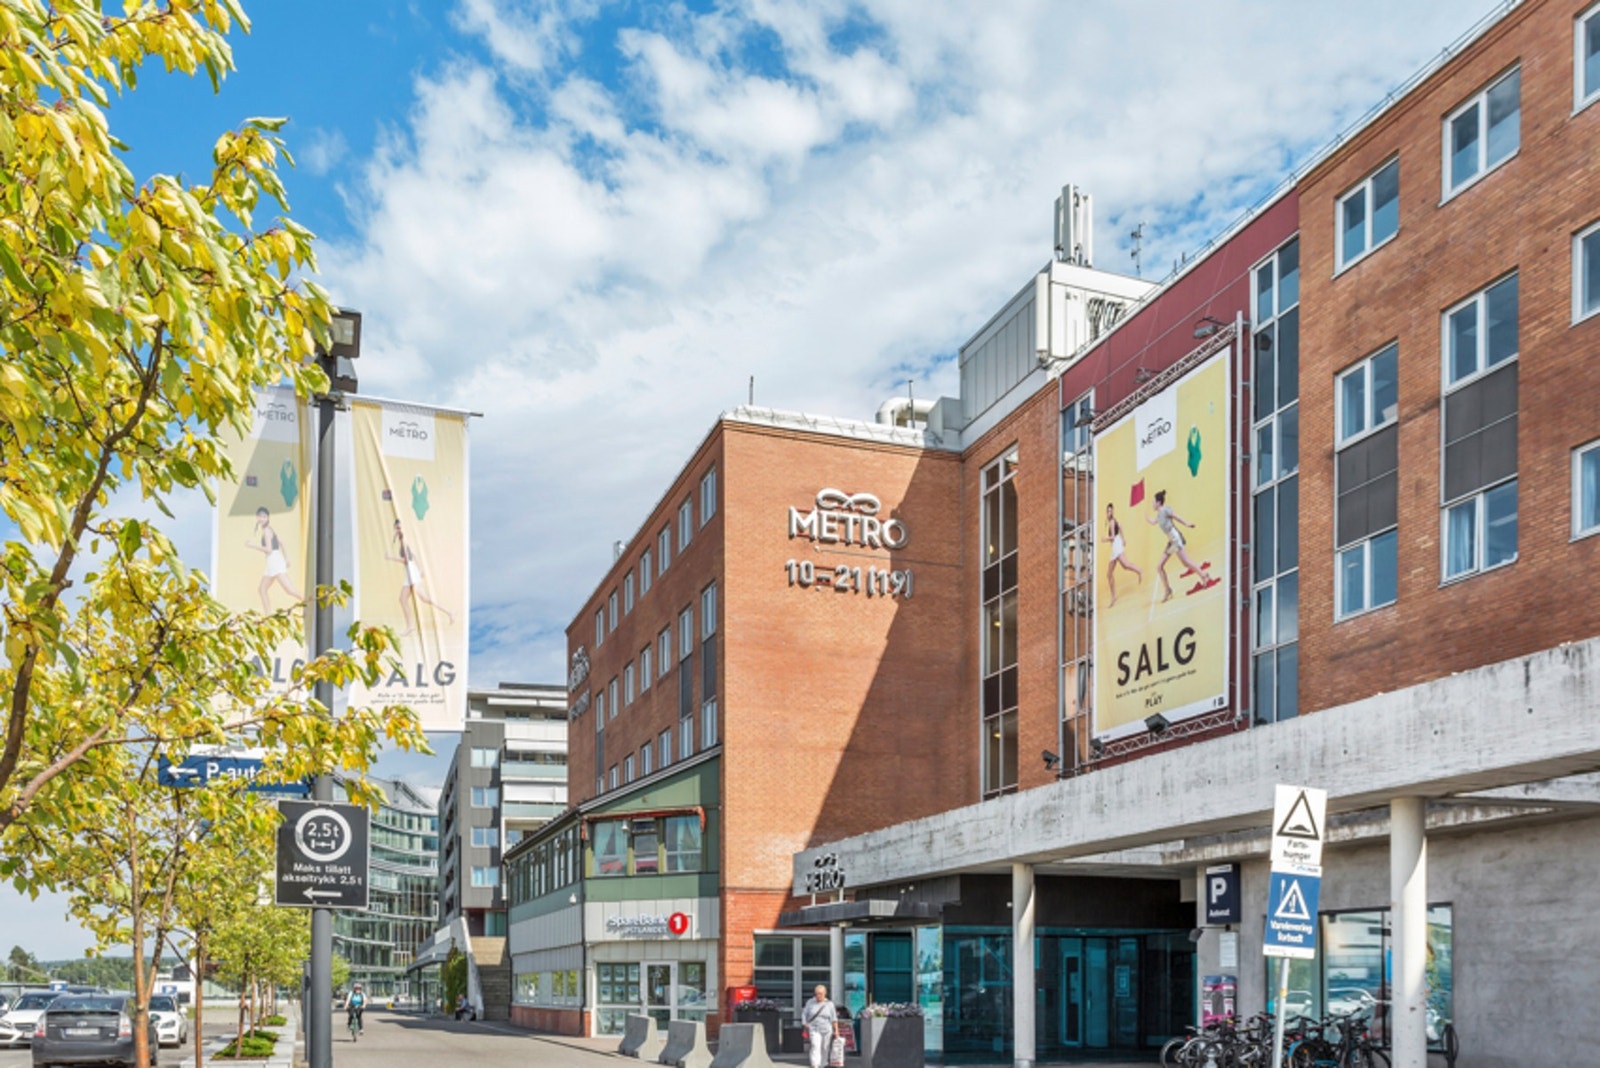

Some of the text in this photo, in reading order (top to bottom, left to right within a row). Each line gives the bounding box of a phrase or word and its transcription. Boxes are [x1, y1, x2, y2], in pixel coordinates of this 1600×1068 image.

[257, 410, 295, 423] METRO
[389, 427, 428, 441] METRO
[1140, 421, 1172, 449] METRO
[788, 505, 908, 550] METRO
[1117, 627, 1196, 686] SALG
[293, 863, 321, 873] Maks
[1211, 877, 1227, 904] P
[673, 916, 682, 930] 1
